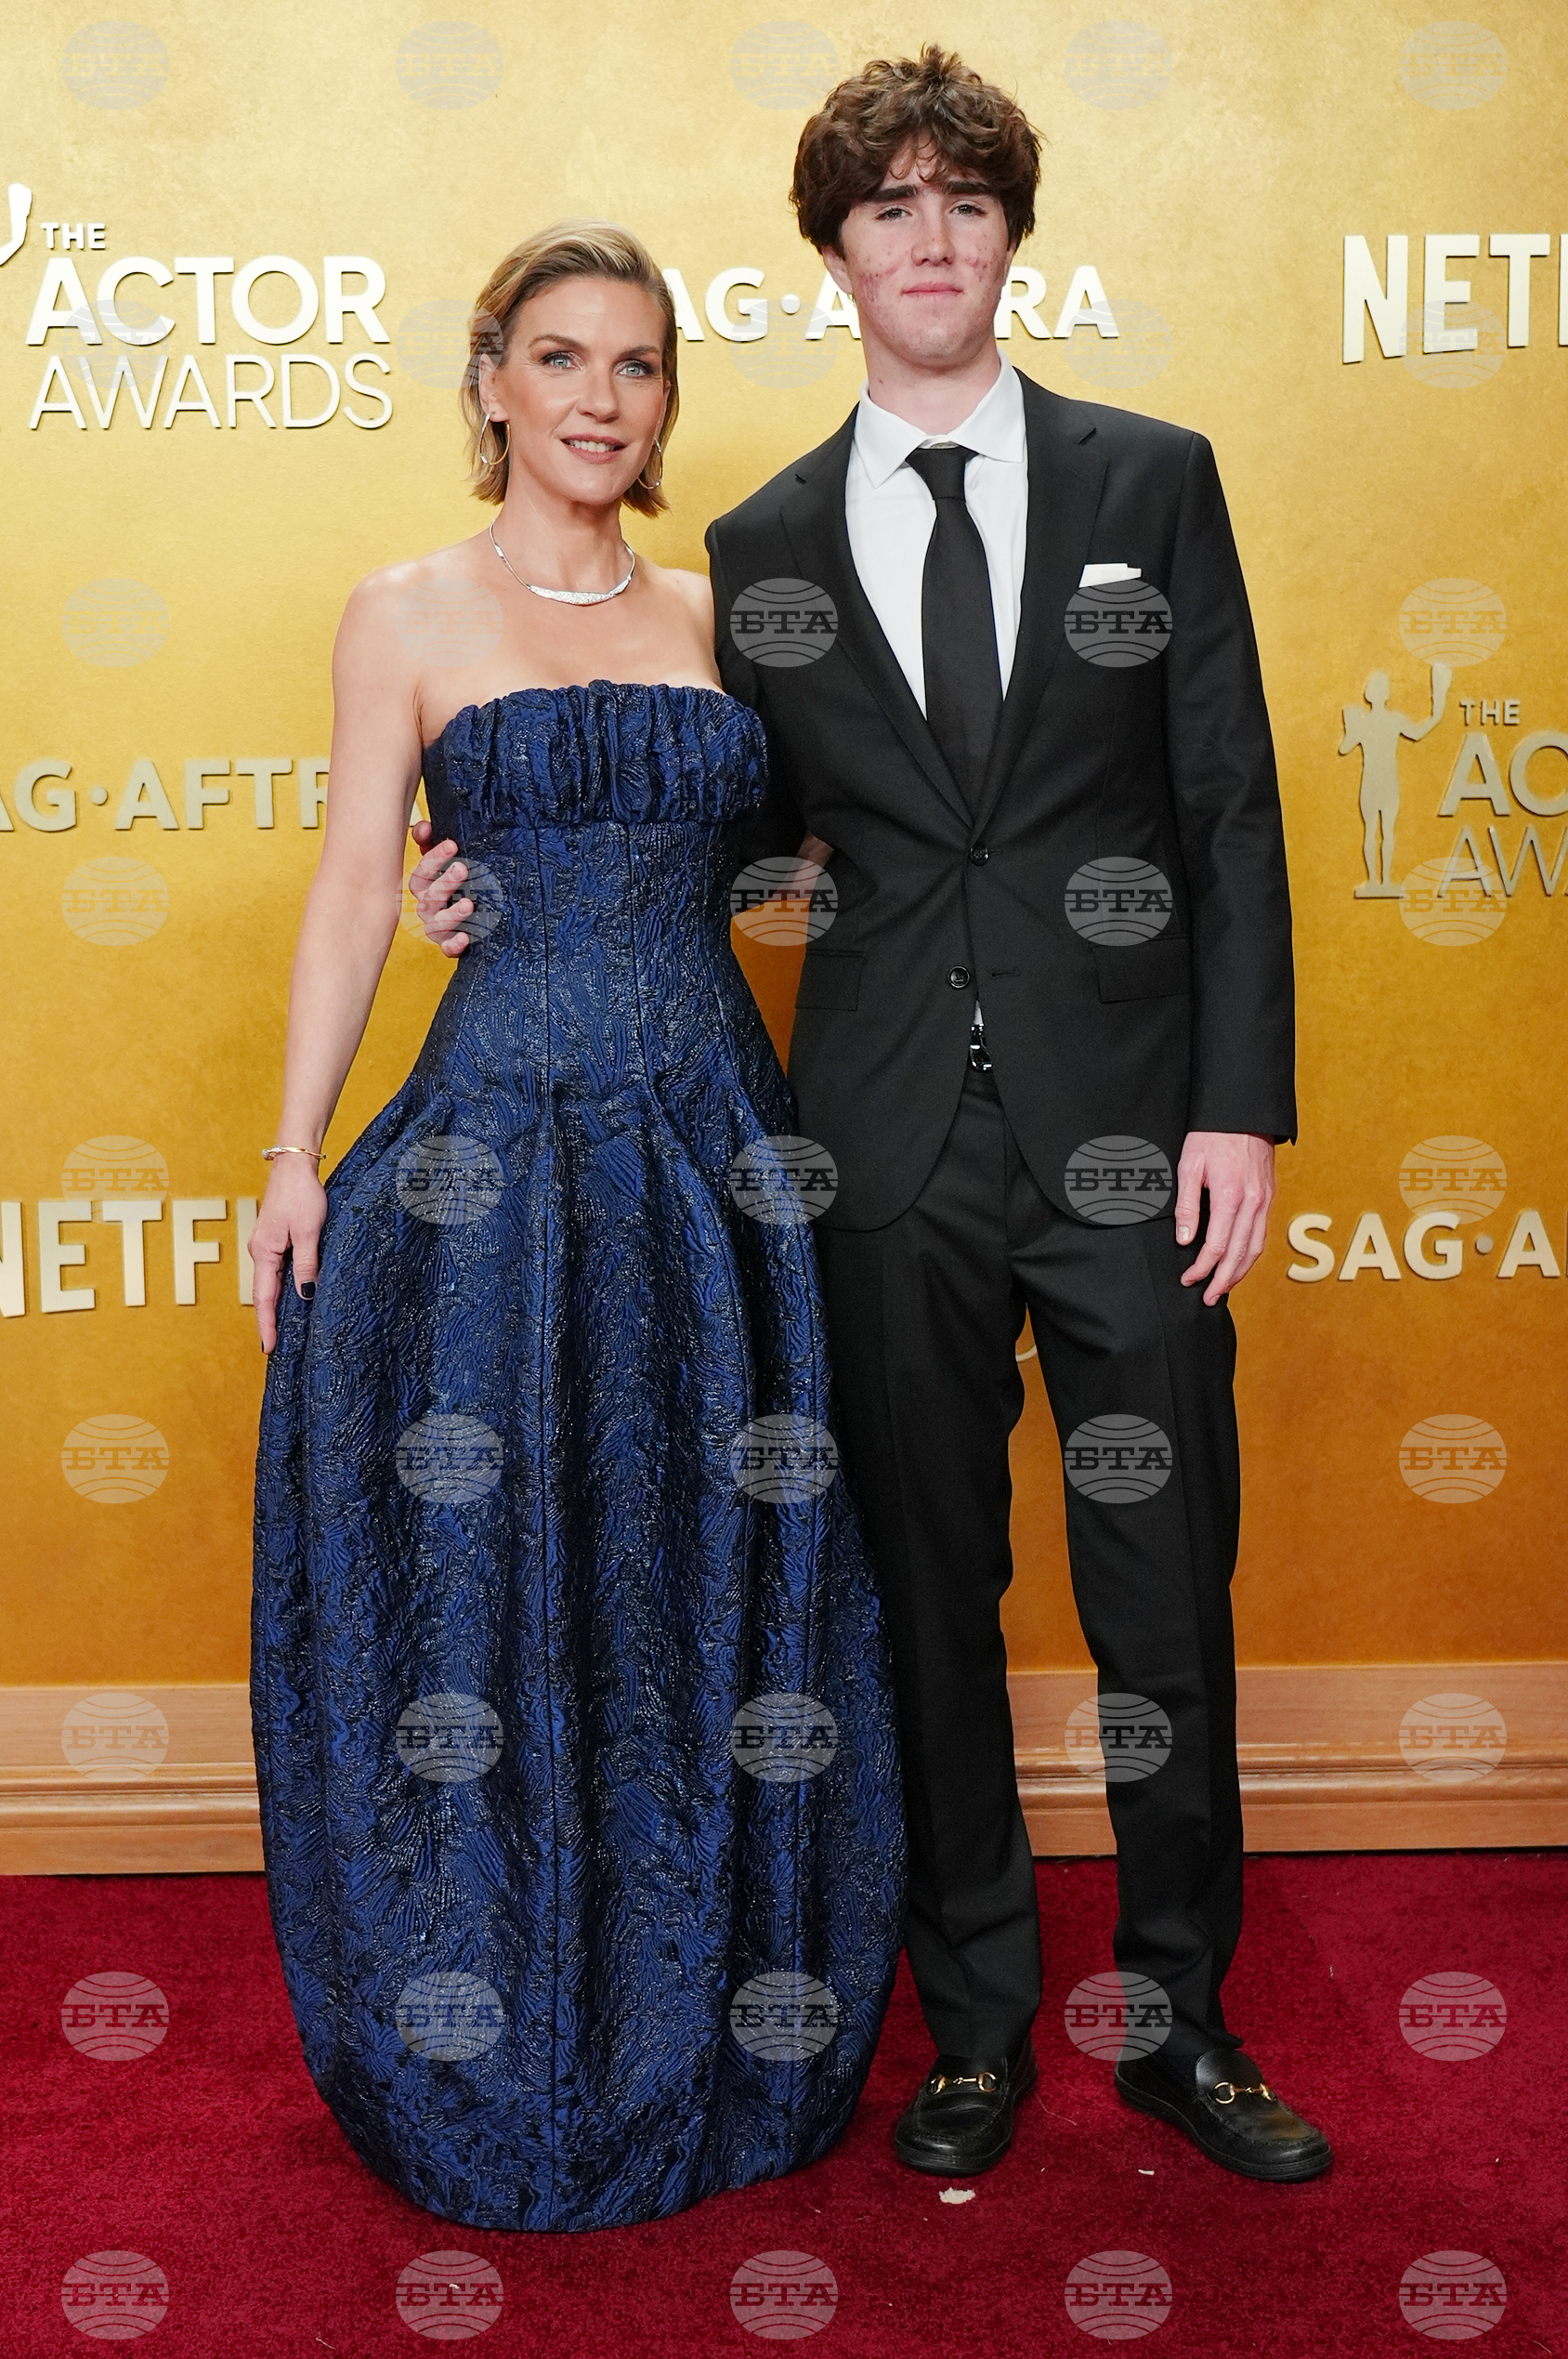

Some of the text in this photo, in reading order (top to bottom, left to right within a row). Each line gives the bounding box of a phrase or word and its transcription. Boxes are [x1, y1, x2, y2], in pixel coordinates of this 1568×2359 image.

[40, 222, 106, 250] THE
[25, 255, 391, 346] ACTOR
[1342, 233, 1568, 364] NET
[29, 352, 393, 430] AWARDS
[1459, 699, 1521, 727] THE
[1437, 825, 1568, 898] AW
